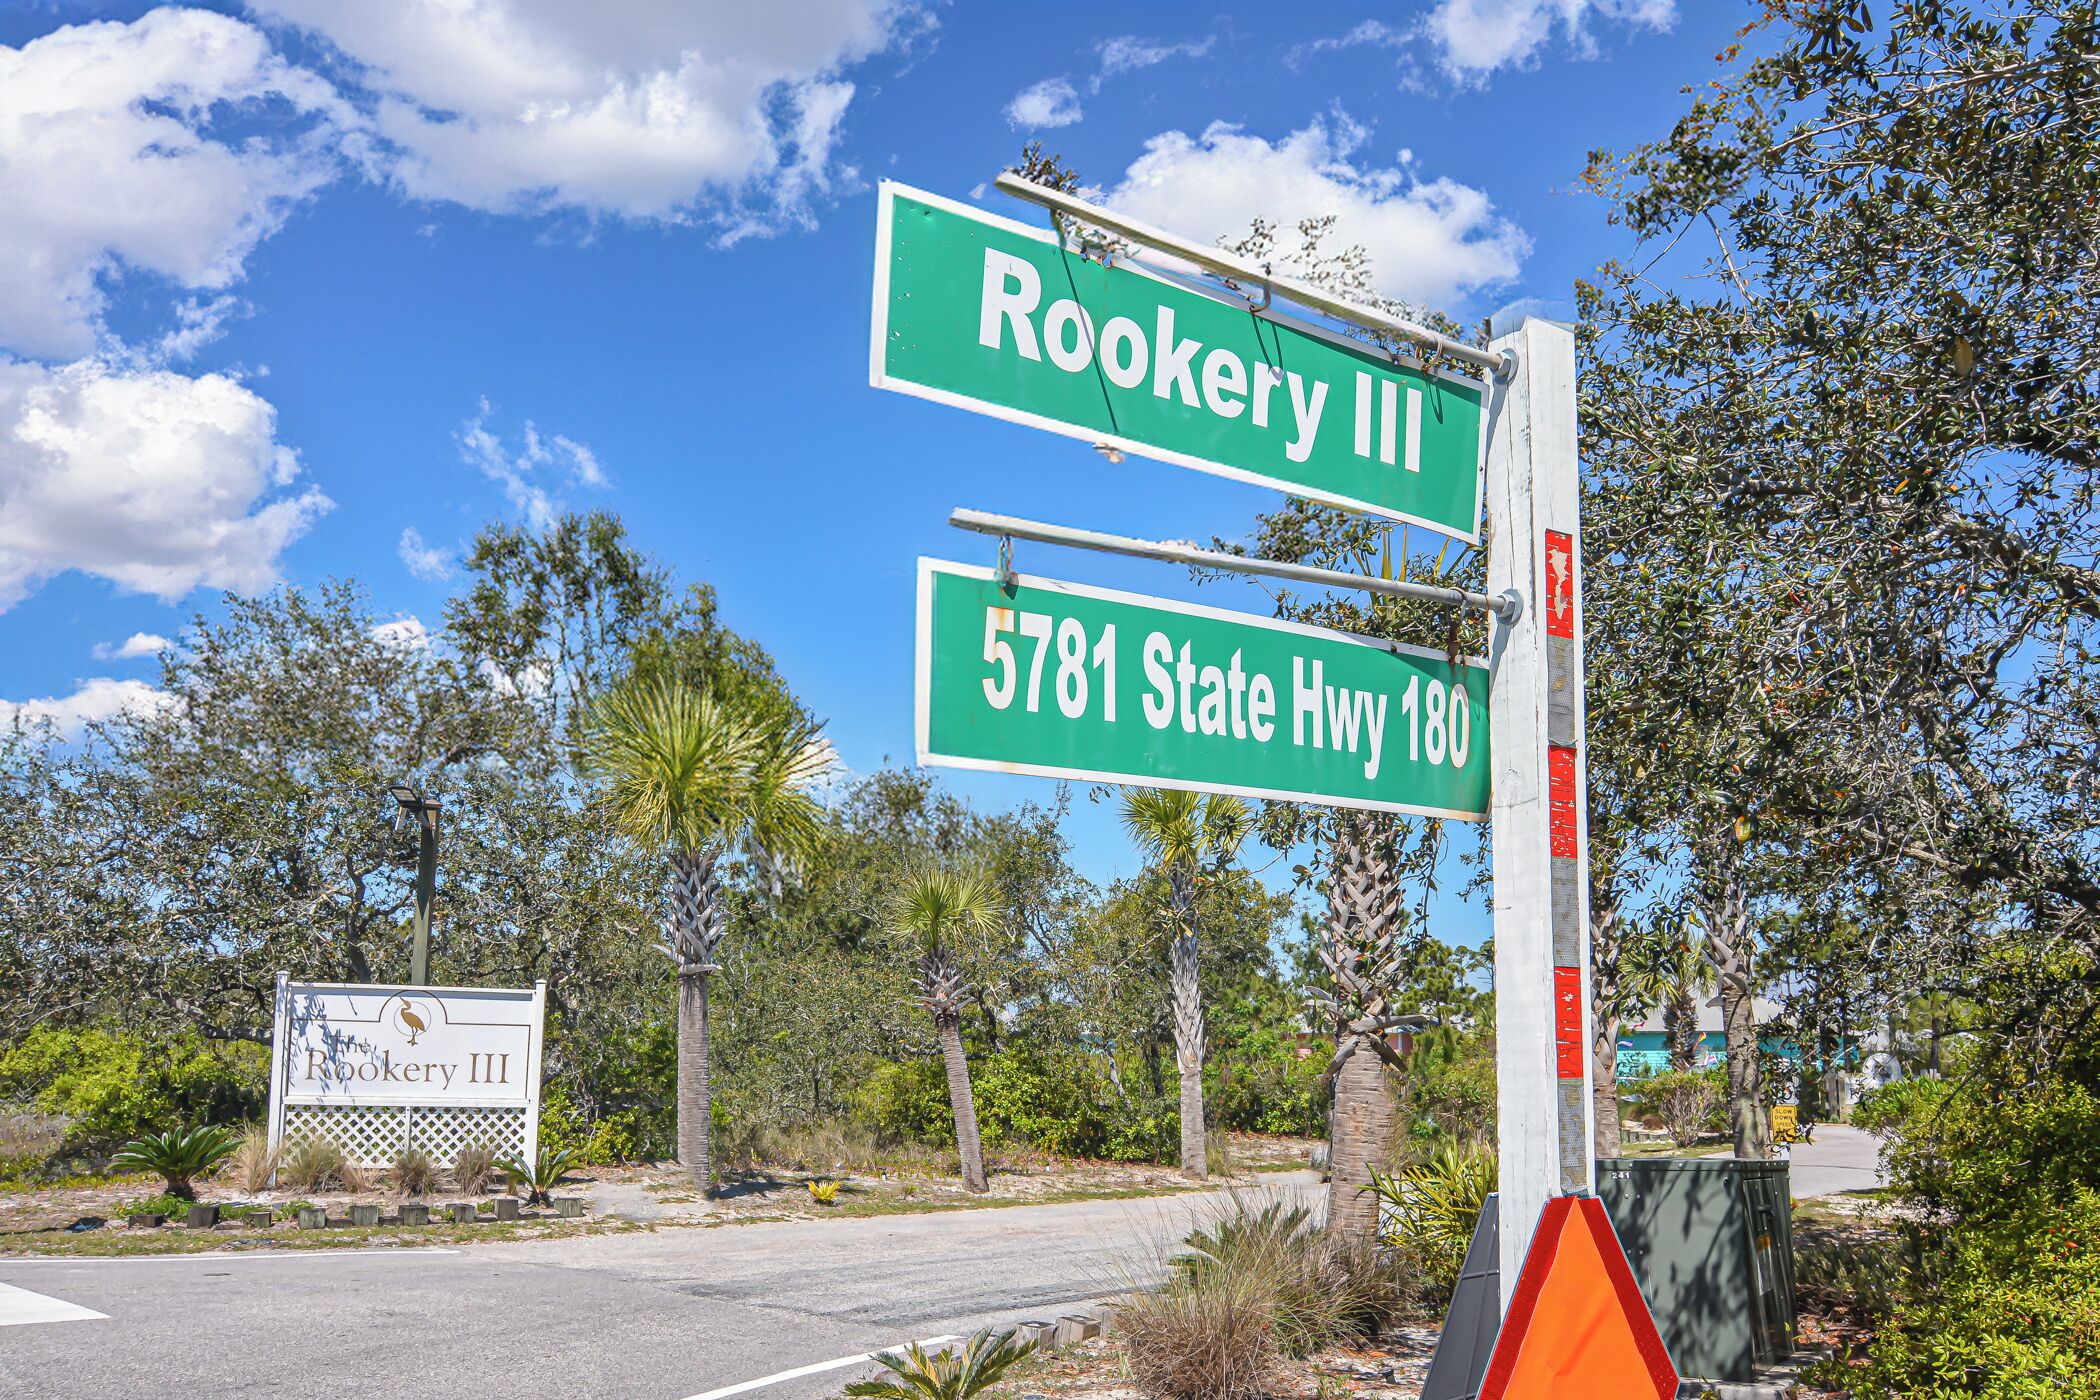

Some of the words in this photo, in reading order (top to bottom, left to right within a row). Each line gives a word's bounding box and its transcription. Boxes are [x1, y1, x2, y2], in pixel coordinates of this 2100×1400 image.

[978, 246, 1329, 464] Rookery
[1354, 371, 1422, 474] III
[982, 605, 1117, 723] 5781
[1141, 630, 1276, 744] State
[1292, 655, 1388, 780] Hwy
[1401, 674, 1470, 769] 180
[305, 1048, 455, 1089] Rookery
[468, 1053, 510, 1084] III
[330, 1035, 371, 1053] The
